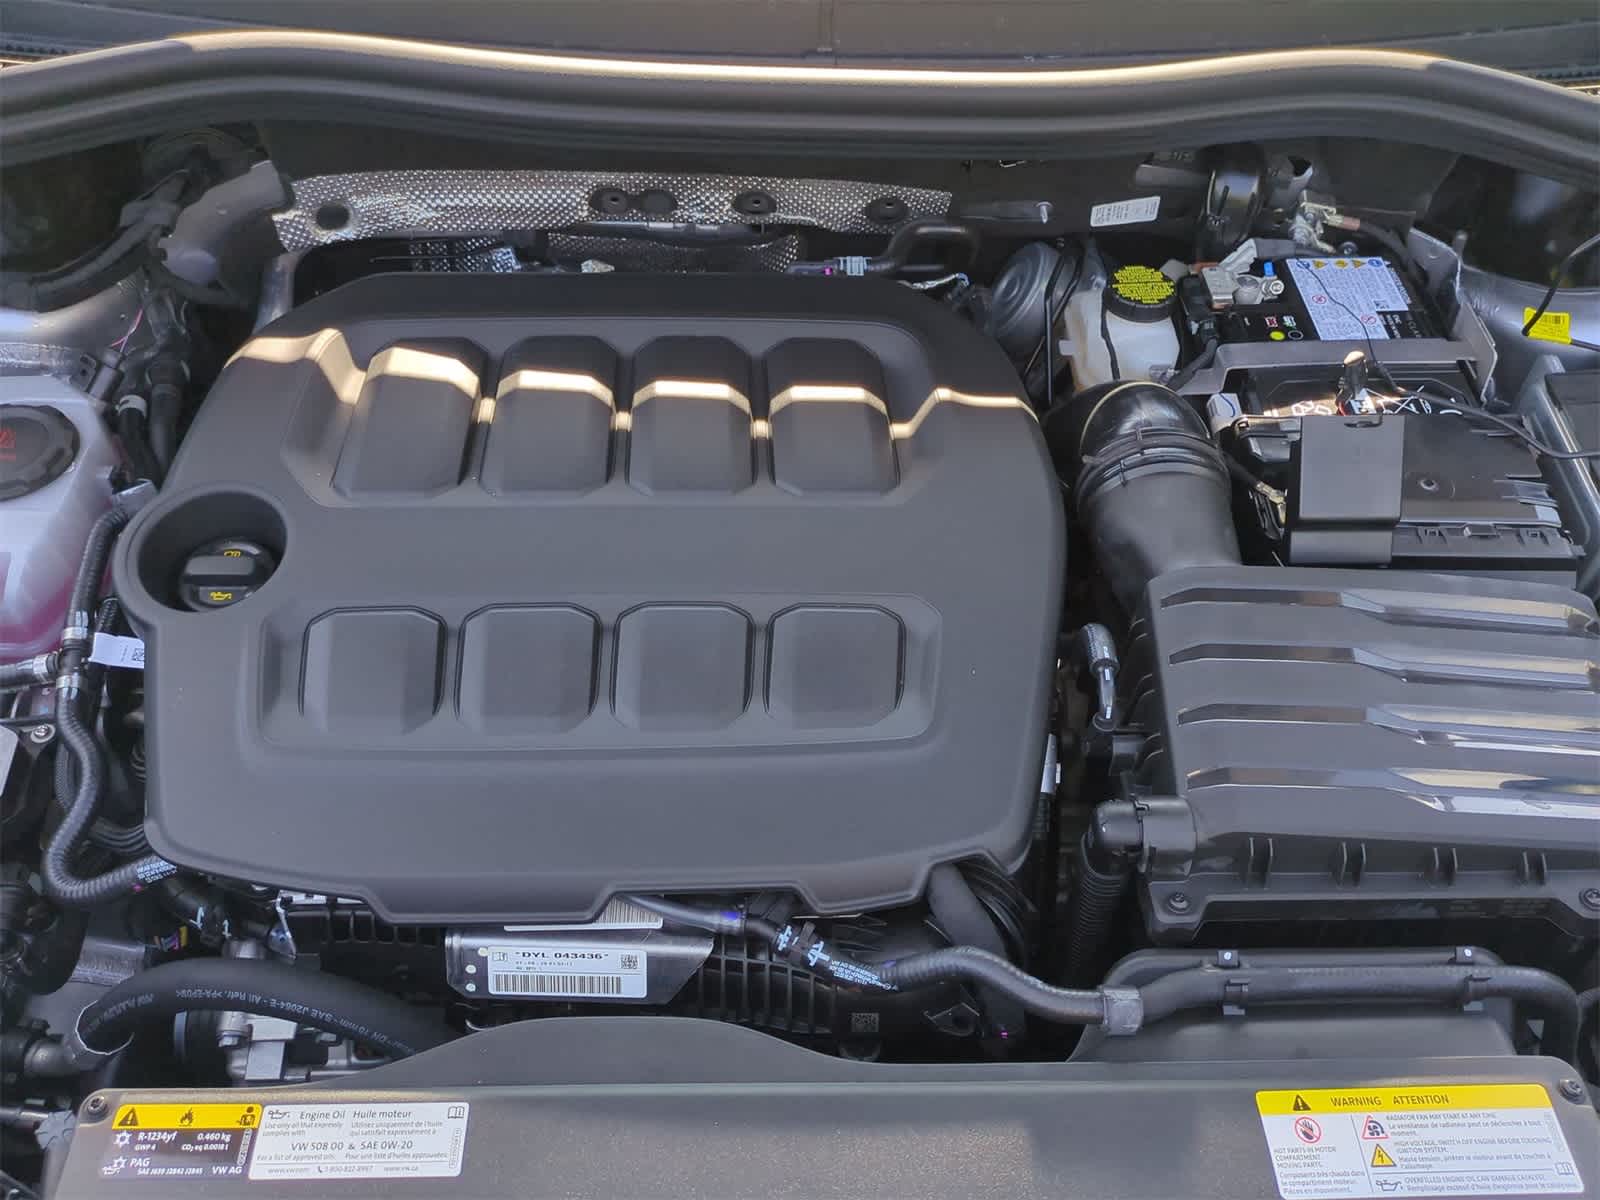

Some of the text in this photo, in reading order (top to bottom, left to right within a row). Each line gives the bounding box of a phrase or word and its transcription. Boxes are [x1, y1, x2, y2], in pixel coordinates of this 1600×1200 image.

[248, 992, 262, 1004] All
[311, 1005, 334, 1022] SAE
[1330, 1094, 1449, 1107] WARNING ATTENTION
[300, 1110, 412, 1121] Engine Oil Huile moteur
[300, 1121, 313, 1129] that
[138, 1131, 232, 1143] R-1234yf 0.460 kg
[291, 1142, 309, 1151] VW
[310, 1142, 329, 1151] 508
[330, 1142, 344, 1150] 00
[360, 1141, 379, 1150] SAE
[380, 1140, 413, 1149] 0W-20
[129, 1157, 151, 1167] PAG
[137, 1167, 150, 1175] SAE
[212, 1165, 228, 1175] VW
[227, 1165, 243, 1175] AG
